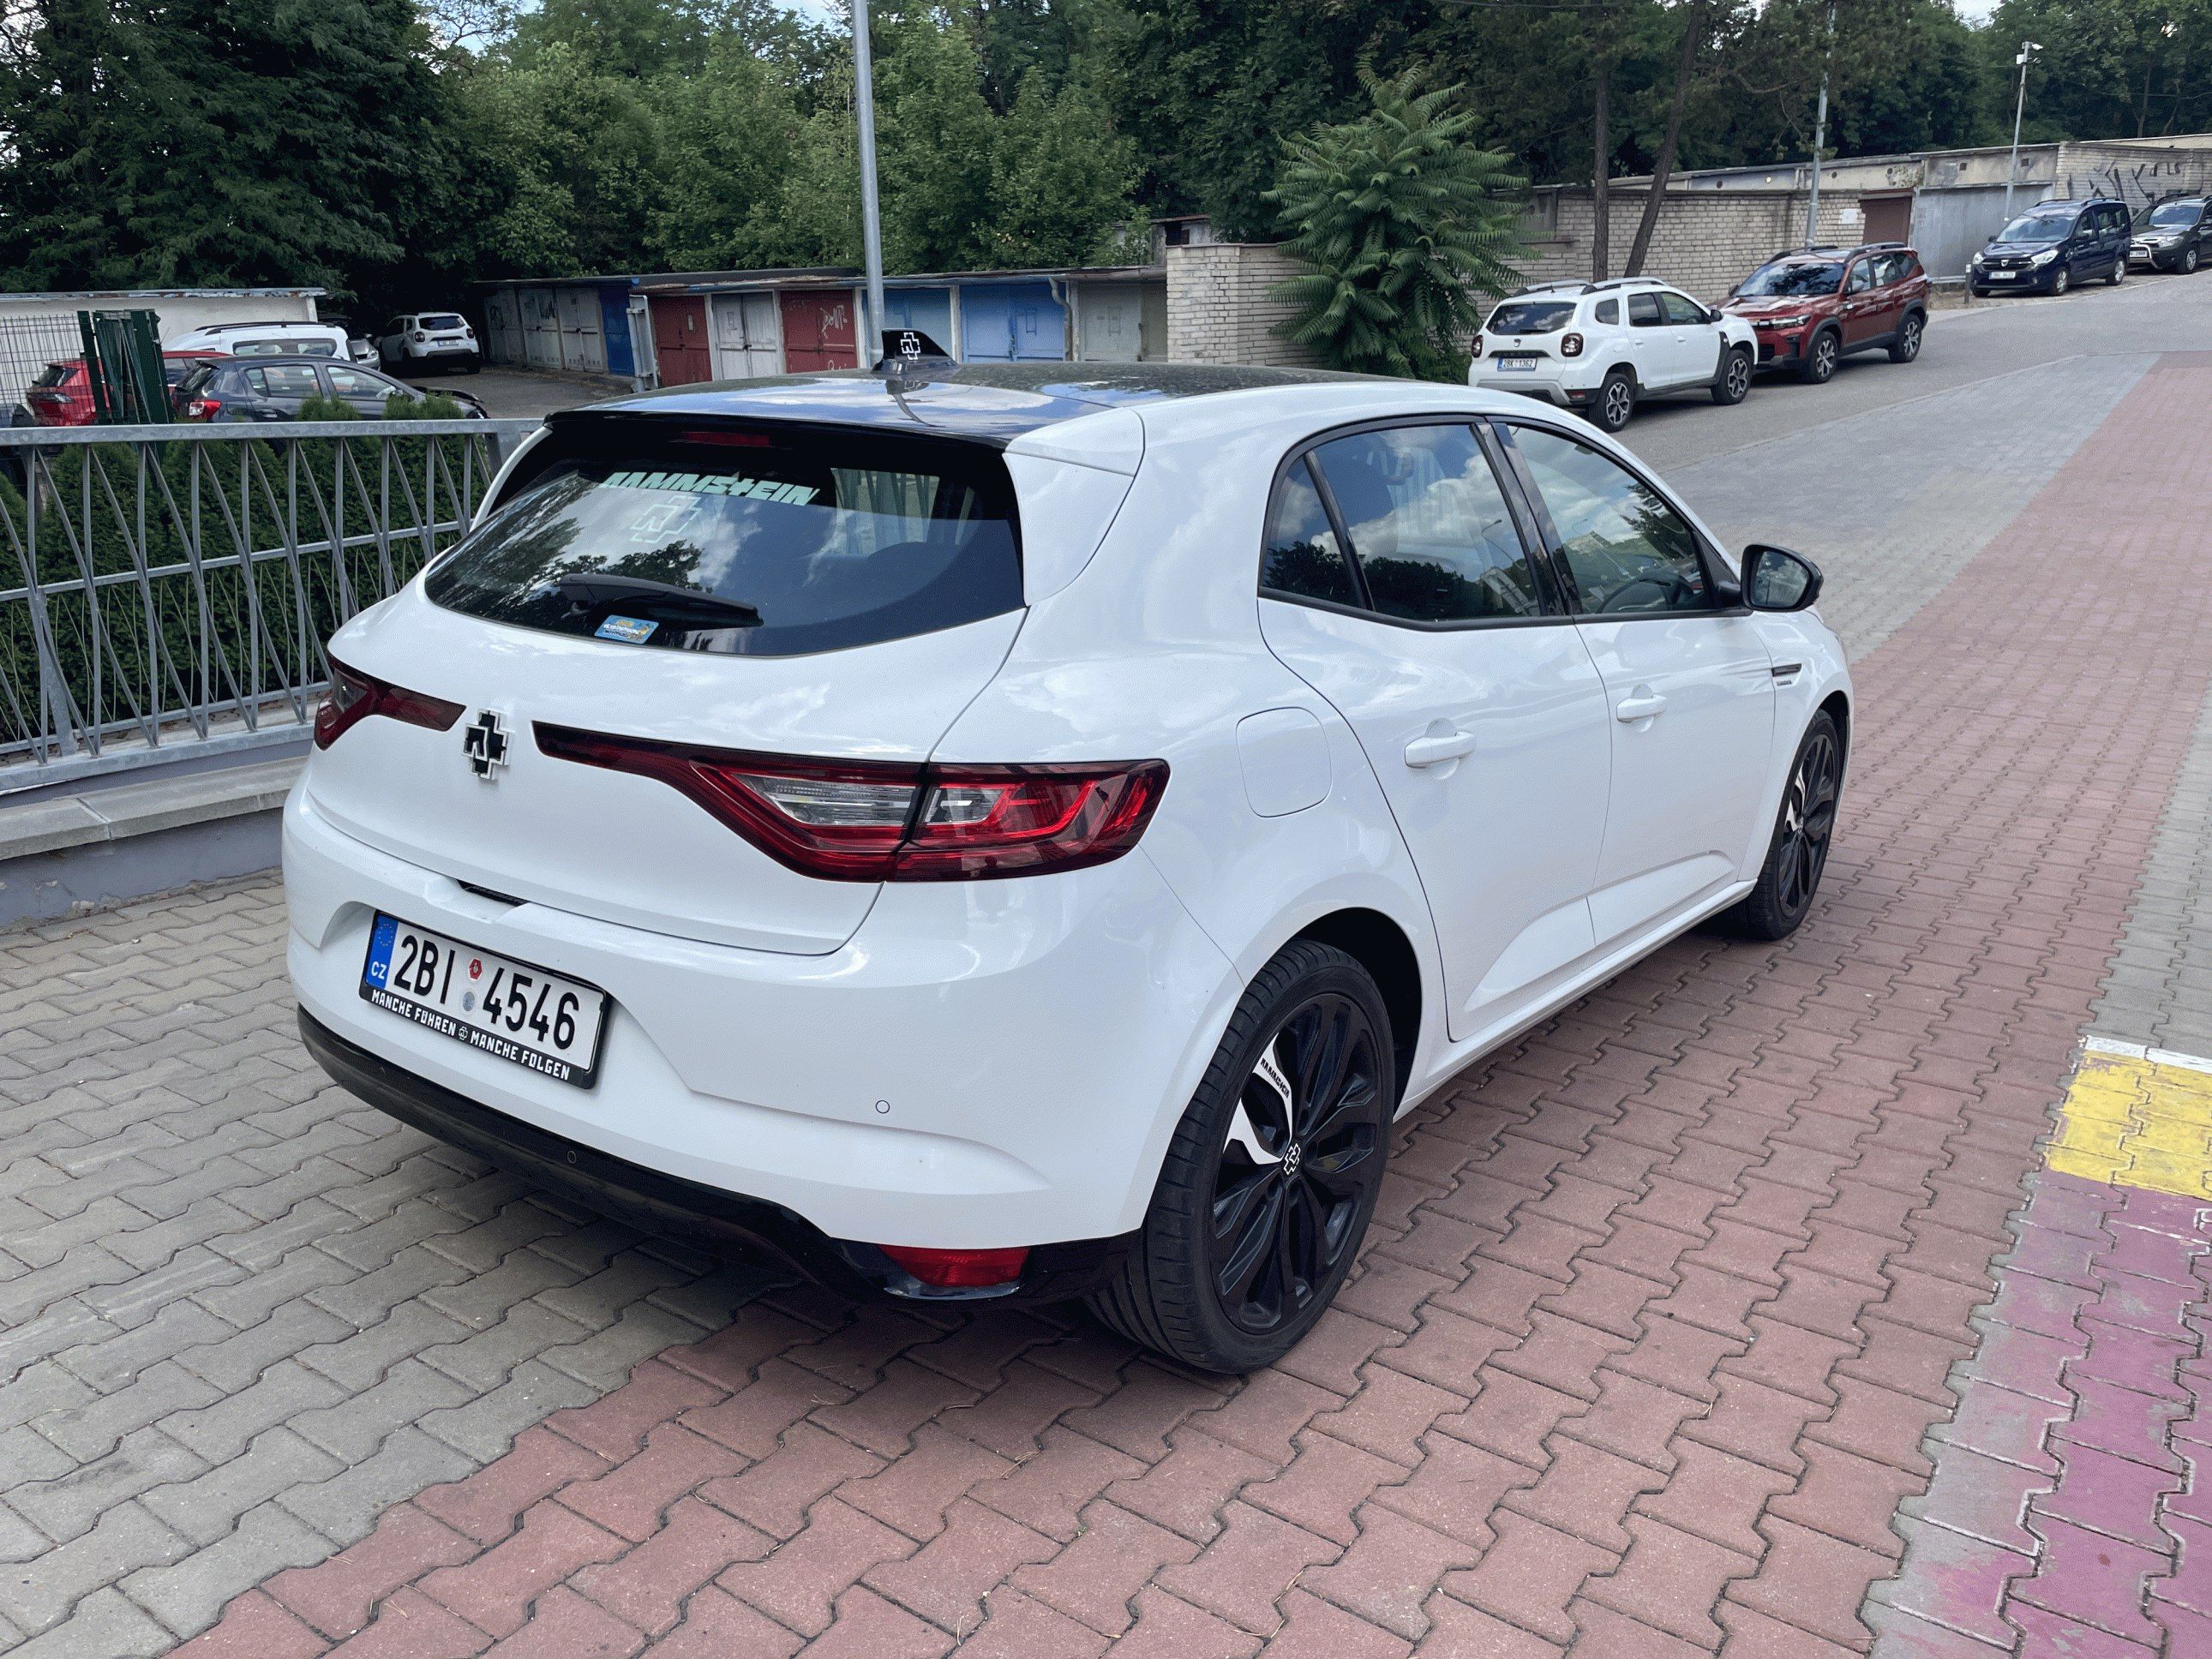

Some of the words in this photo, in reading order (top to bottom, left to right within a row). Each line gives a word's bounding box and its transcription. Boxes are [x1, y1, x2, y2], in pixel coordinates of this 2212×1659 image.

[600, 472, 820, 506] RAMMSTEIN
[371, 961, 386, 979] CZ
[393, 935, 456, 1004] 2BI
[483, 967, 579, 1050] 4546
[371, 989, 412, 1017] MANCHE
[470, 1030, 519, 1061] MANCHE
[521, 1050, 570, 1081] FOLGEN
